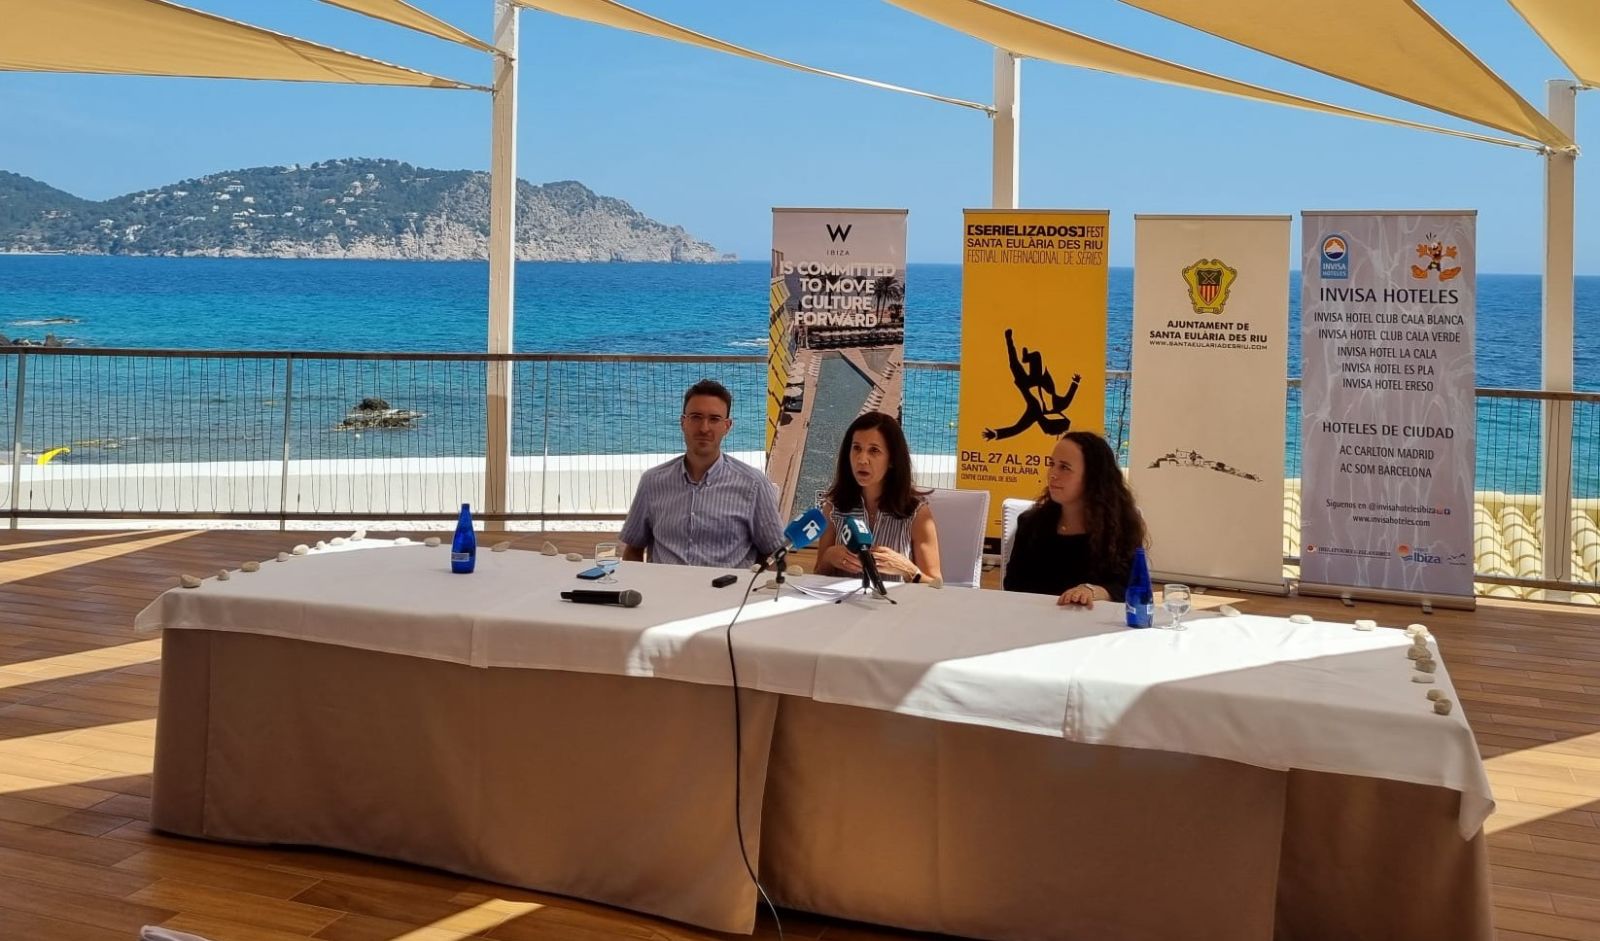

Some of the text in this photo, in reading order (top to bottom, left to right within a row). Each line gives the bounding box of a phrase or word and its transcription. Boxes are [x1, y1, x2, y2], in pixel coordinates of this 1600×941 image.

[826, 224, 852, 243] W
[967, 238, 1003, 248] SANTA
[1058, 240, 1081, 250] DES
[1084, 240, 1104, 250] RIU
[967, 249, 1103, 265] FESTIVAL INTERNACIONAL DE SERIES
[780, 260, 897, 277] IS COMMITTED
[800, 278, 876, 294] TO MOVE
[801, 294, 873, 311] CULTURE
[1320, 287, 1459, 305] INVISA HOTELES
[794, 311, 878, 328] FORWARD
[1167, 320, 1250, 332] AJUNTAMENT DE
[1314, 312, 1464, 326] INVISA HOTEL CLUB CALA BLANCA
[1149, 330, 1182, 340] SANTA
[1228, 333, 1247, 343] DES
[1250, 334, 1268, 343] RIU
[1318, 329, 1461, 343] INVISA HOTEL CLUB CALA VERDE
[1337, 346, 1437, 360] INVISA HOTEL LA CALA
[1341, 362, 1435, 376] INVISA HOTEL ES PLA
[1342, 378, 1434, 392] INVISA HOTEL ERESO
[1322, 421, 1455, 440] HOTELES DE CIUDAD
[961, 450, 1056, 467] DEL 27 AL 29 D
[1339, 445, 1435, 461] AC CARLTON MADRID
[960, 463, 989, 472] SANTA
[1340, 463, 1432, 478] AC SOM BARCELONA
[1358, 502, 1367, 510] en
[1352, 515, 1431, 527] www.invisahoteles.com
[1413, 552, 1441, 564] Ibiza
